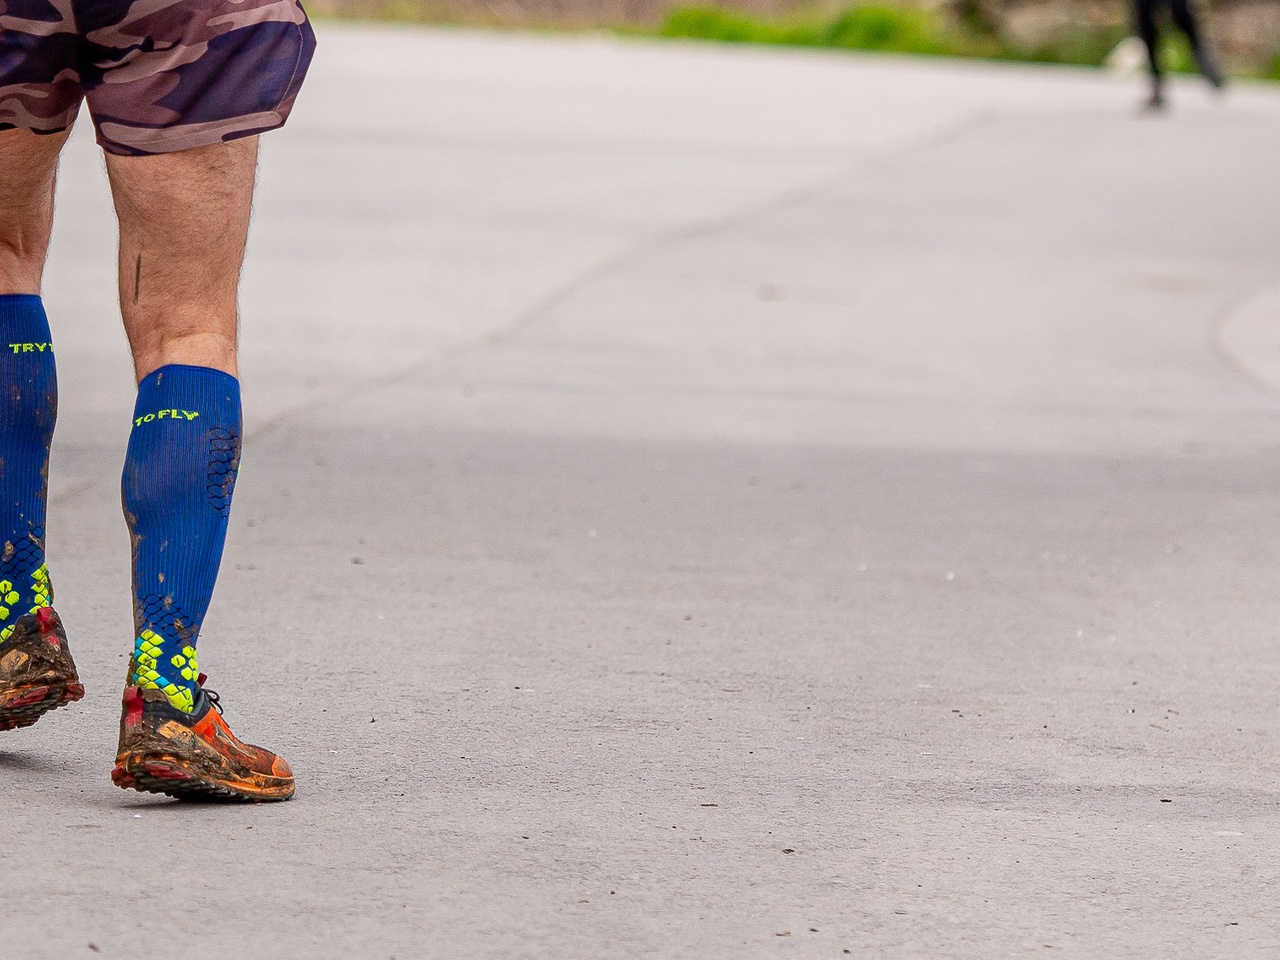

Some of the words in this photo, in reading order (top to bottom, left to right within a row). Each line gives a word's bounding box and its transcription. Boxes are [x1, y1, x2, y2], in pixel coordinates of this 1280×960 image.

[8, 342, 47, 354] TRY
[135, 413, 156, 427] TO
[158, 408, 199, 421] FLY
